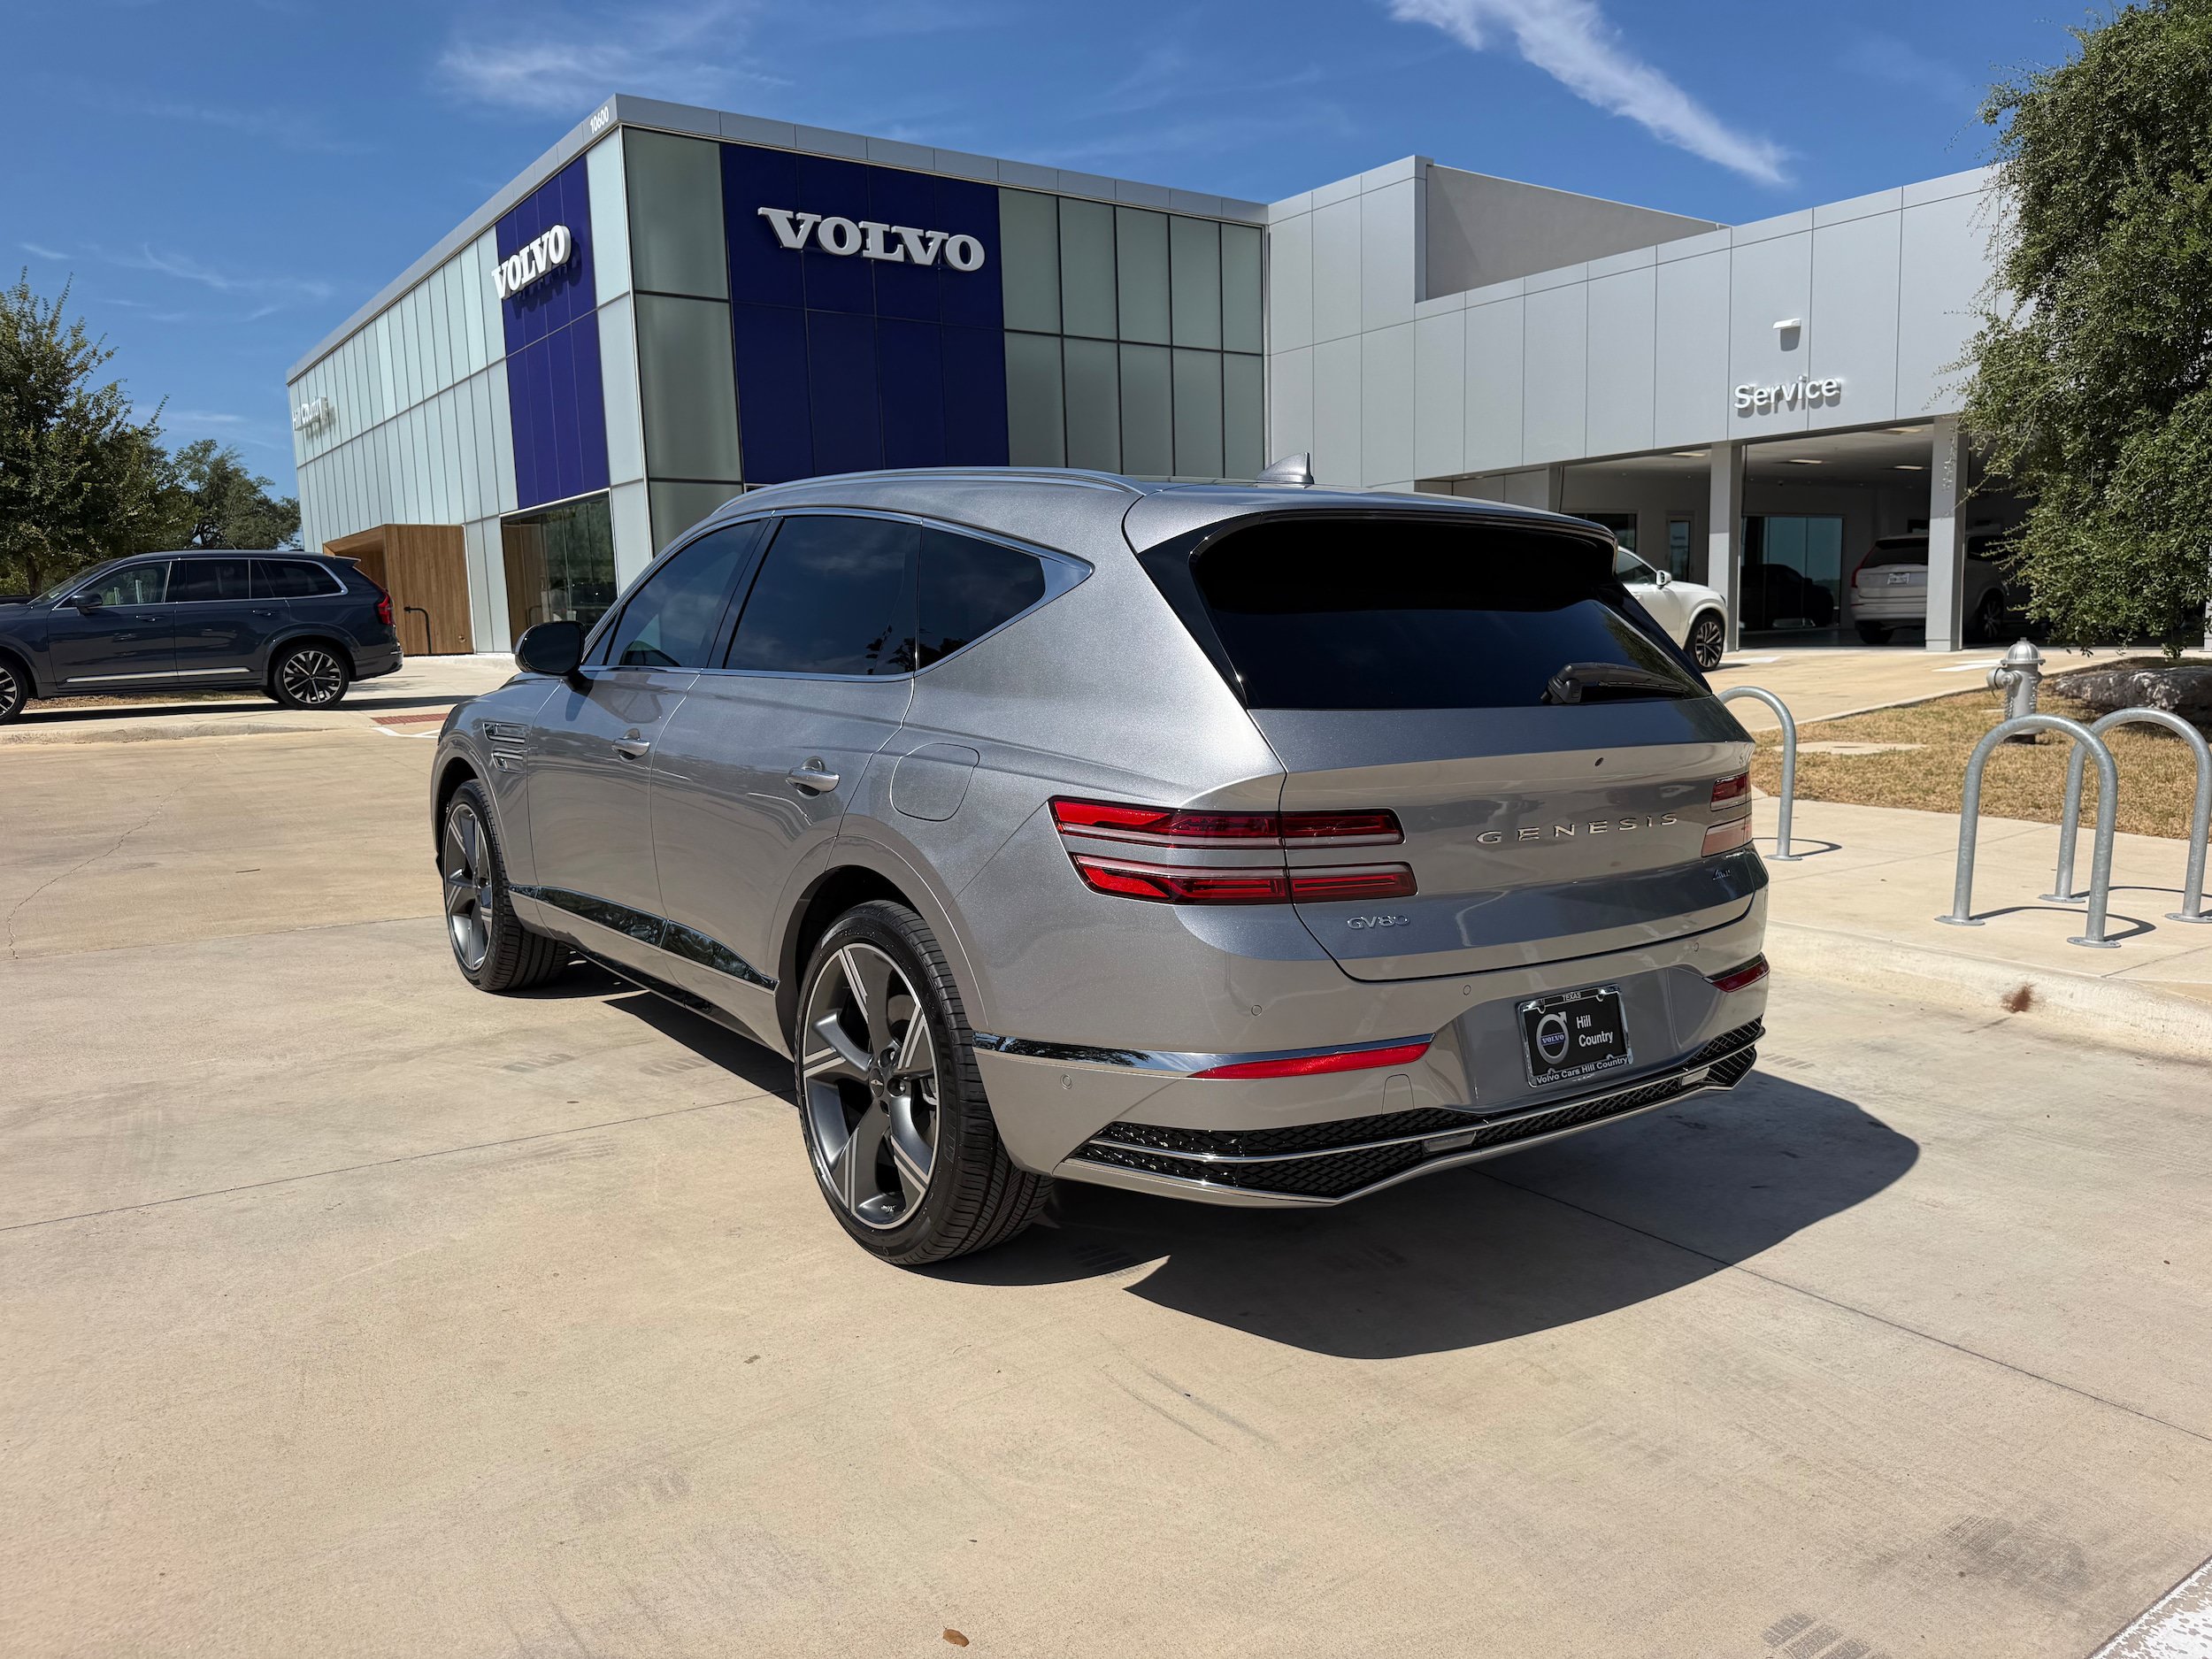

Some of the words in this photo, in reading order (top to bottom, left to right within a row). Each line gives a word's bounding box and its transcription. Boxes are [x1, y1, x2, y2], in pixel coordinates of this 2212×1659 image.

[590, 105, 610, 134] 10600
[757, 206, 986, 272] VOLVO
[491, 224, 572, 299] VOLVO
[1733, 374, 1841, 409] Service
[1476, 812, 1678, 844] GENESIS
[1347, 915, 1410, 930] GV80
[1562, 992, 1582, 1002] TEXAS
[1576, 1014, 1592, 1029] Hill
[1541, 1033, 1565, 1044] VOLVO
[1578, 1031, 1613, 1048] Country
[1536, 1072, 1560, 1084] Volvo
[1561, 1068, 1580, 1079] Cars
[1581, 1063, 1596, 1073] Hill
[1596, 1056, 1628, 1070] Country
